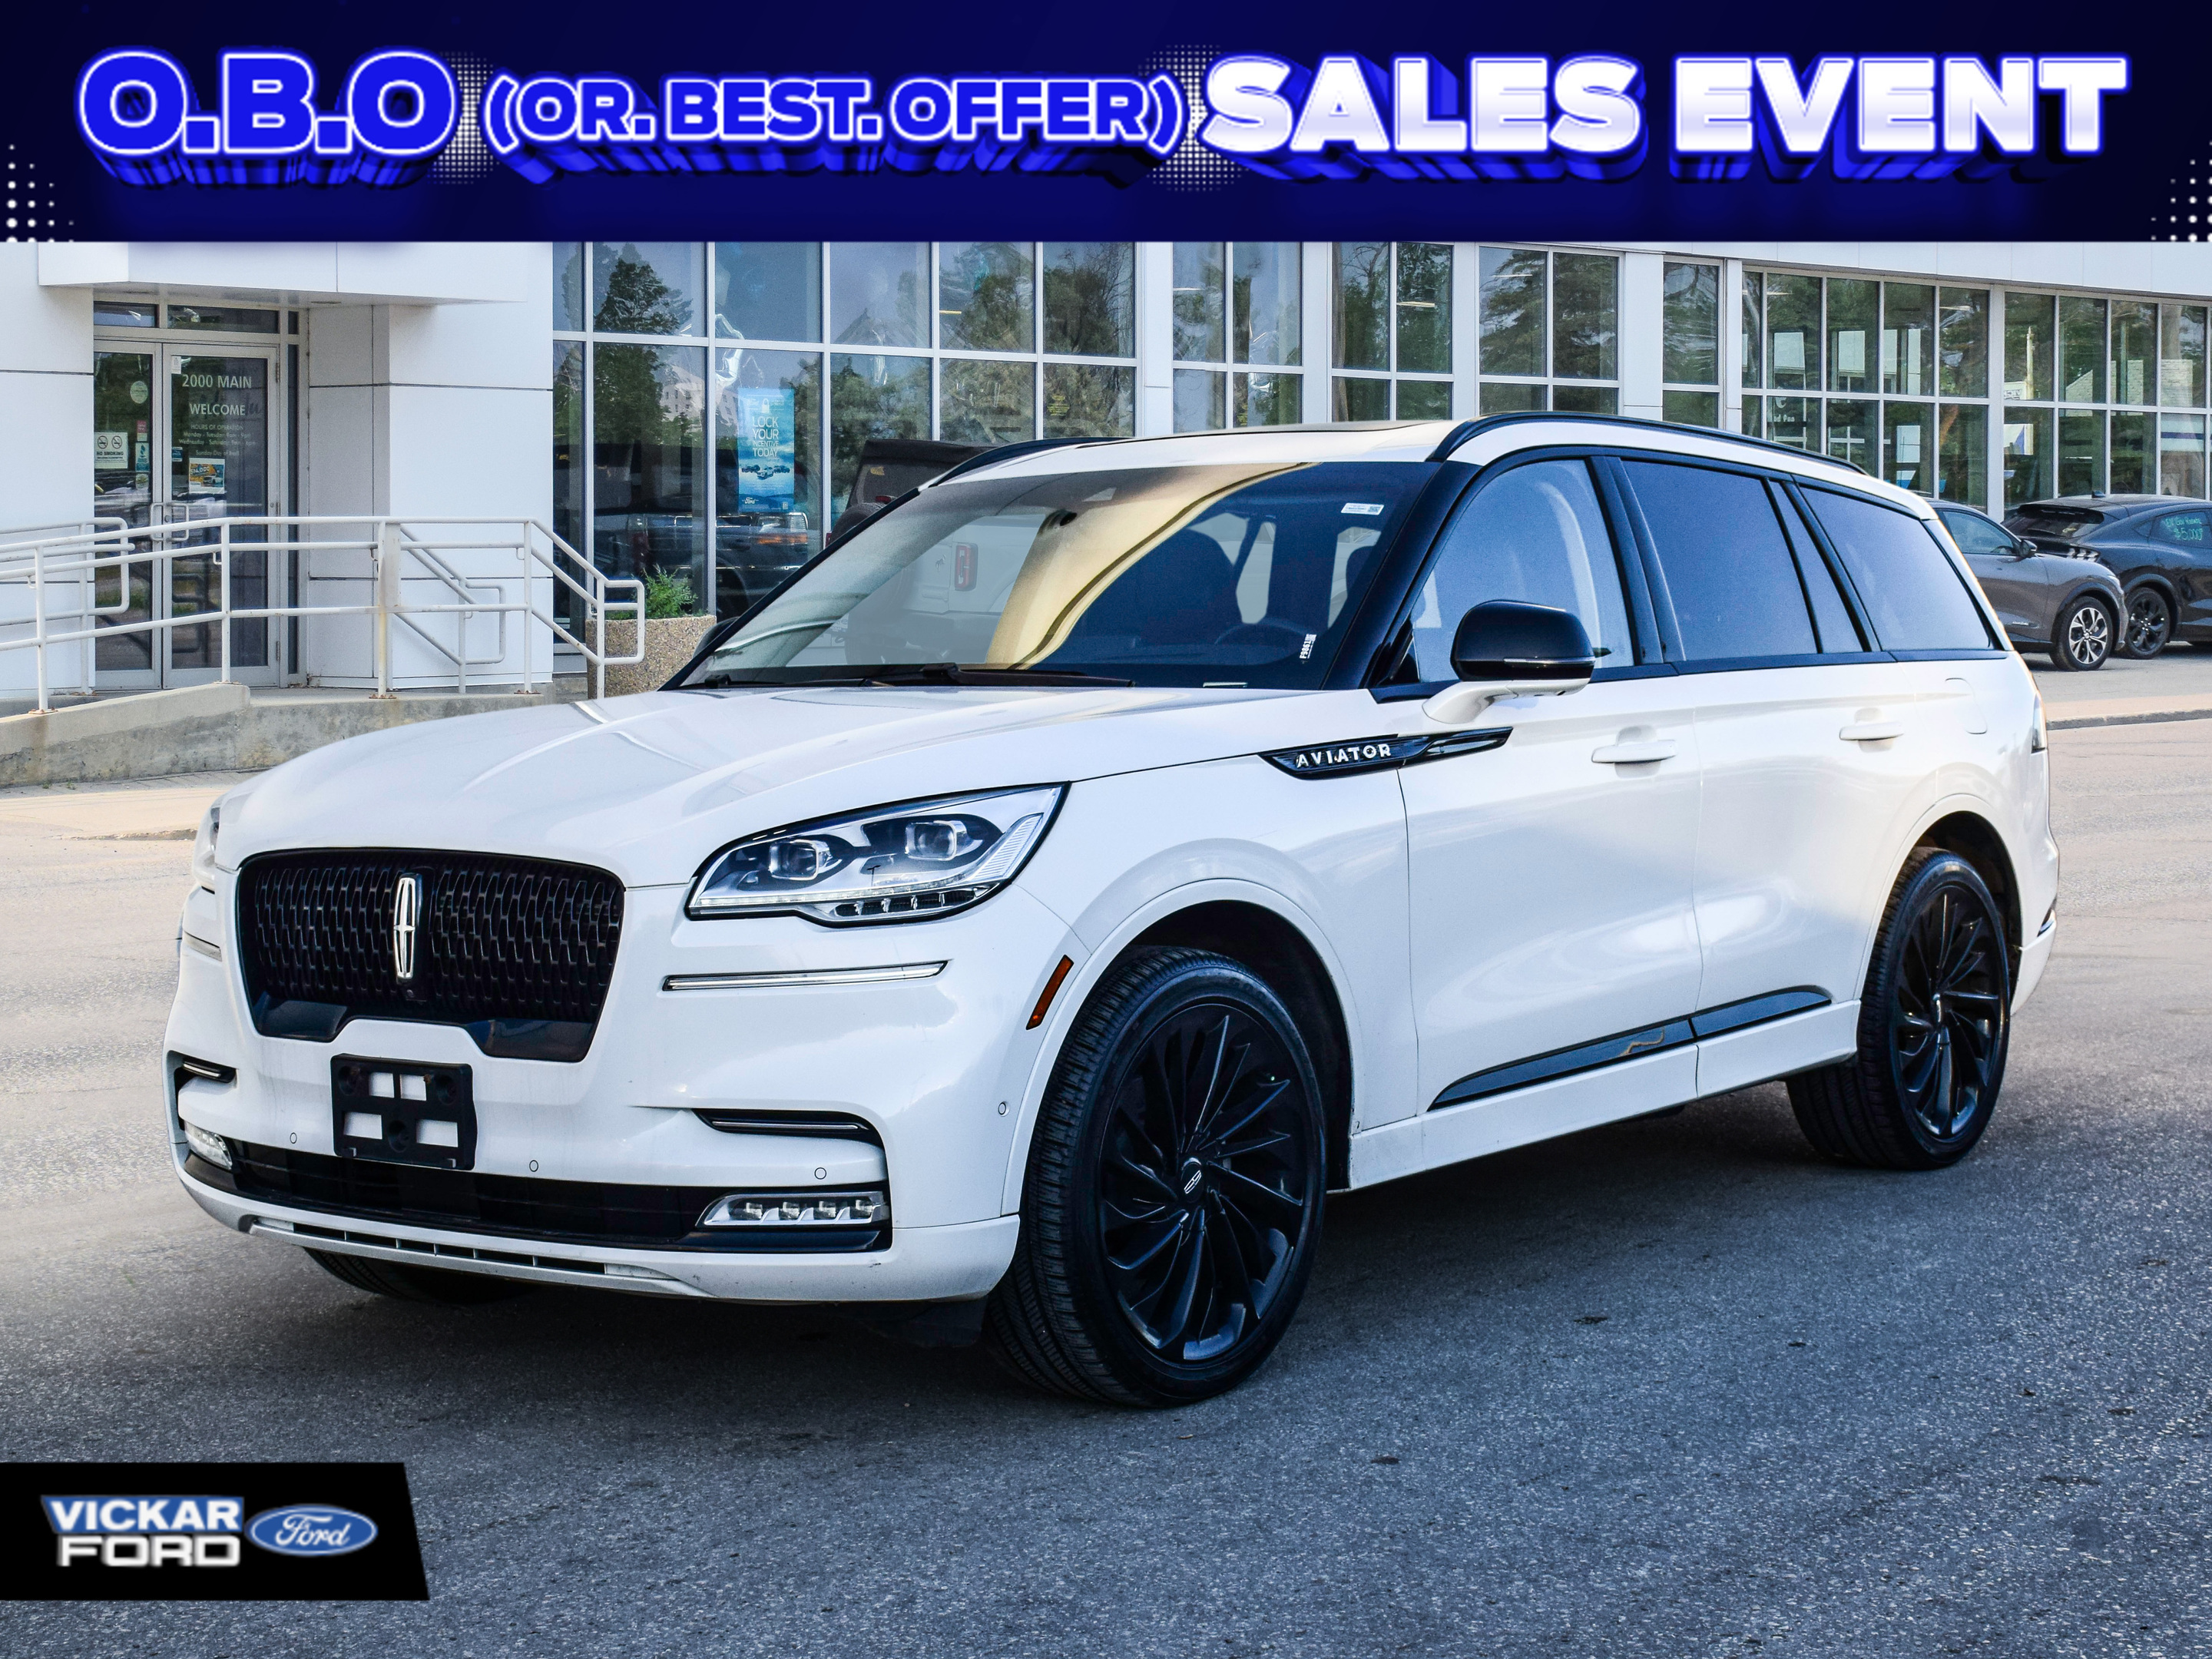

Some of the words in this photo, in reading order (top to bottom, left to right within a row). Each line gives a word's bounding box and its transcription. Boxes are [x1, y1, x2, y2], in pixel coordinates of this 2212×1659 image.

[182, 374, 214, 388] 2000
[217, 375, 252, 389] MAIN
[189, 402, 246, 416] WELCOME
[752, 416, 779, 428] LOCK
[752, 429, 779, 439] YOUR
[753, 448, 778, 457] TODAY
[1296, 743, 1392, 768] AVIATOR
